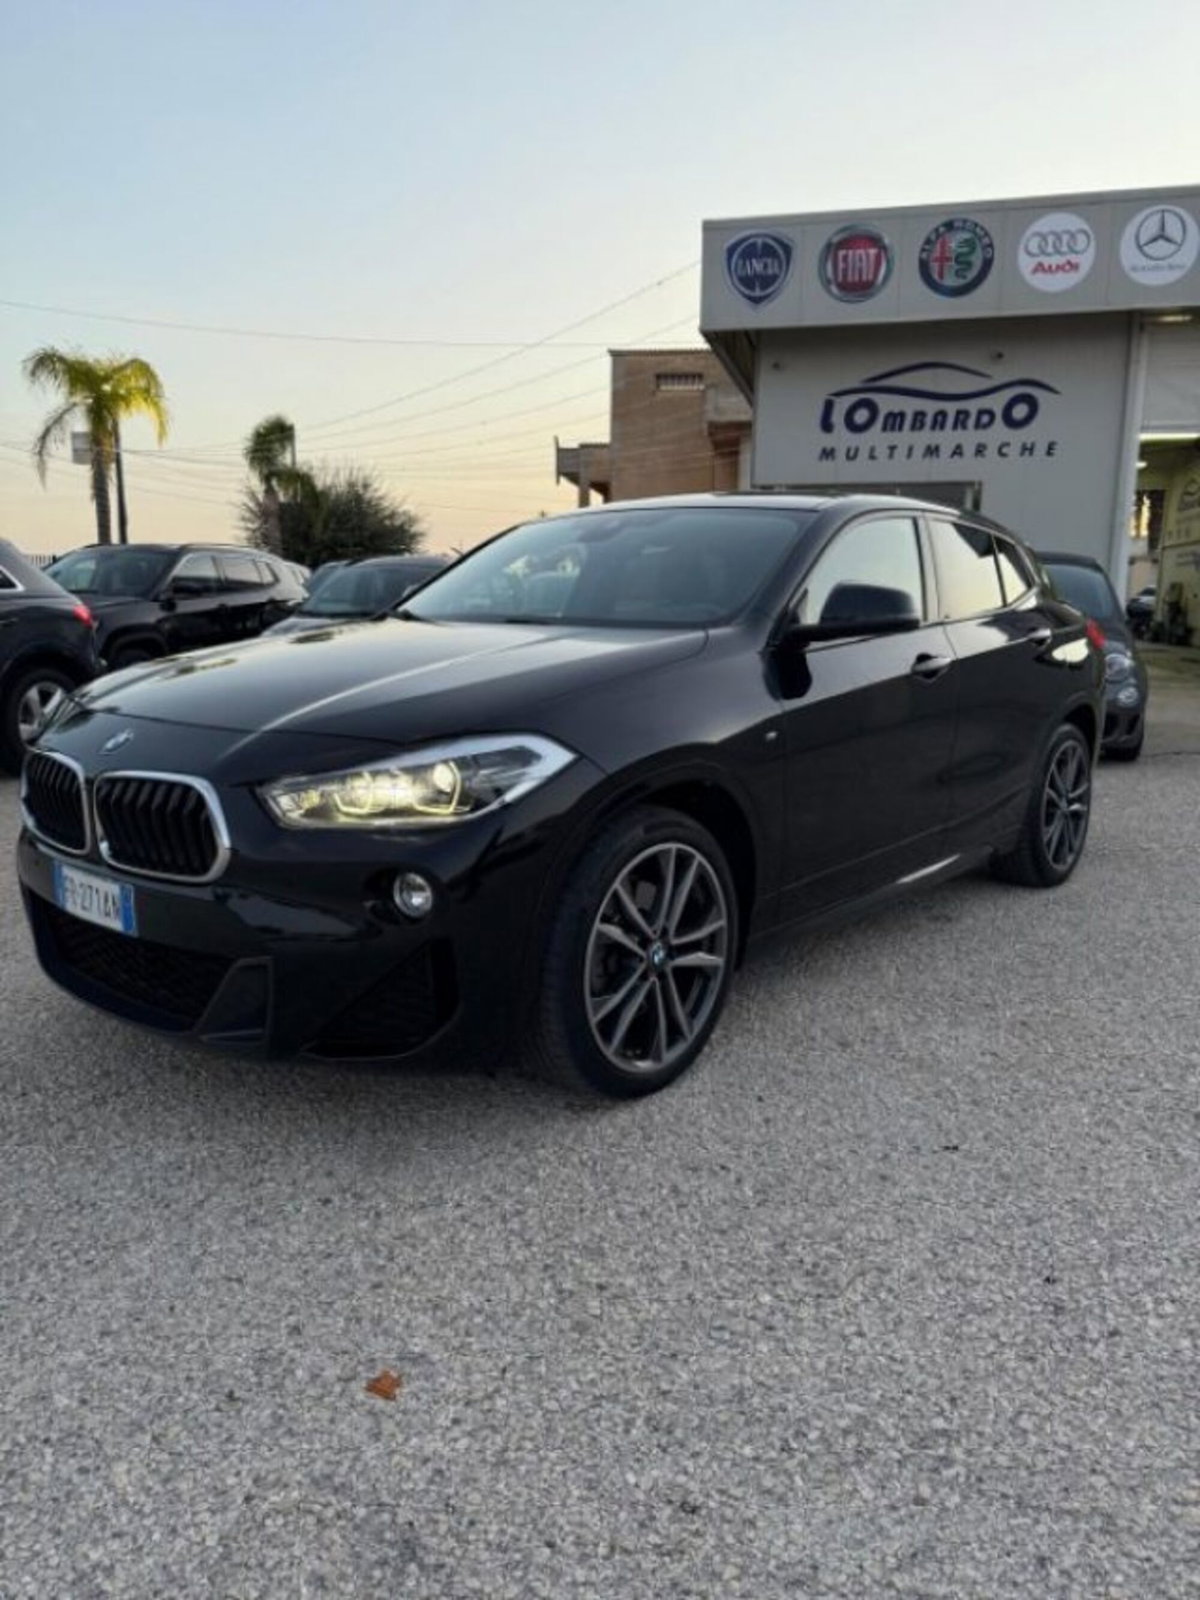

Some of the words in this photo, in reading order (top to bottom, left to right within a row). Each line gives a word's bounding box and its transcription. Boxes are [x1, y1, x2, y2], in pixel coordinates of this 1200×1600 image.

[737, 258, 780, 277] LANCIA
[837, 249, 877, 283] FIAT
[1030, 258, 1081, 276] Audi
[818, 441, 1058, 462] MULTIMARCHE
